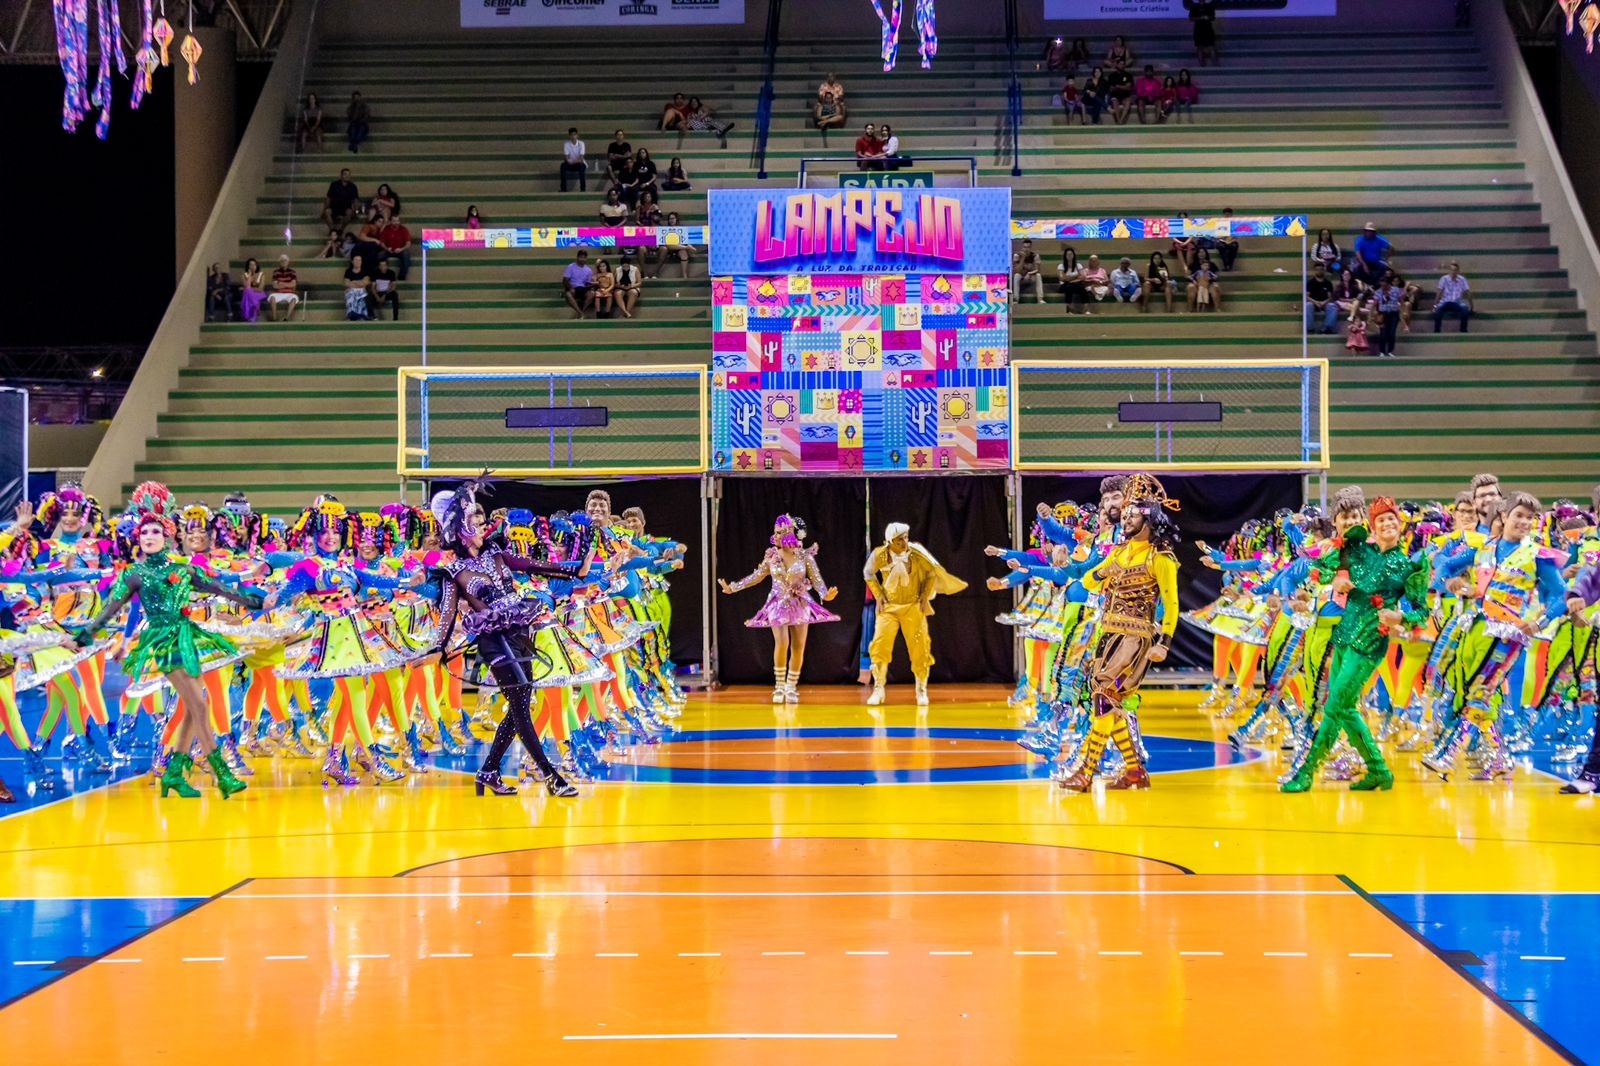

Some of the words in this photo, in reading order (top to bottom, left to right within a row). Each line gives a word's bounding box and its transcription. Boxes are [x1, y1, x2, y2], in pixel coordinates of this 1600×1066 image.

[621, 5, 656, 14] CORINGA
[754, 190, 964, 262] LAMPEJO
[811, 264, 832, 273] LUZ
[838, 264, 854, 273] DA
